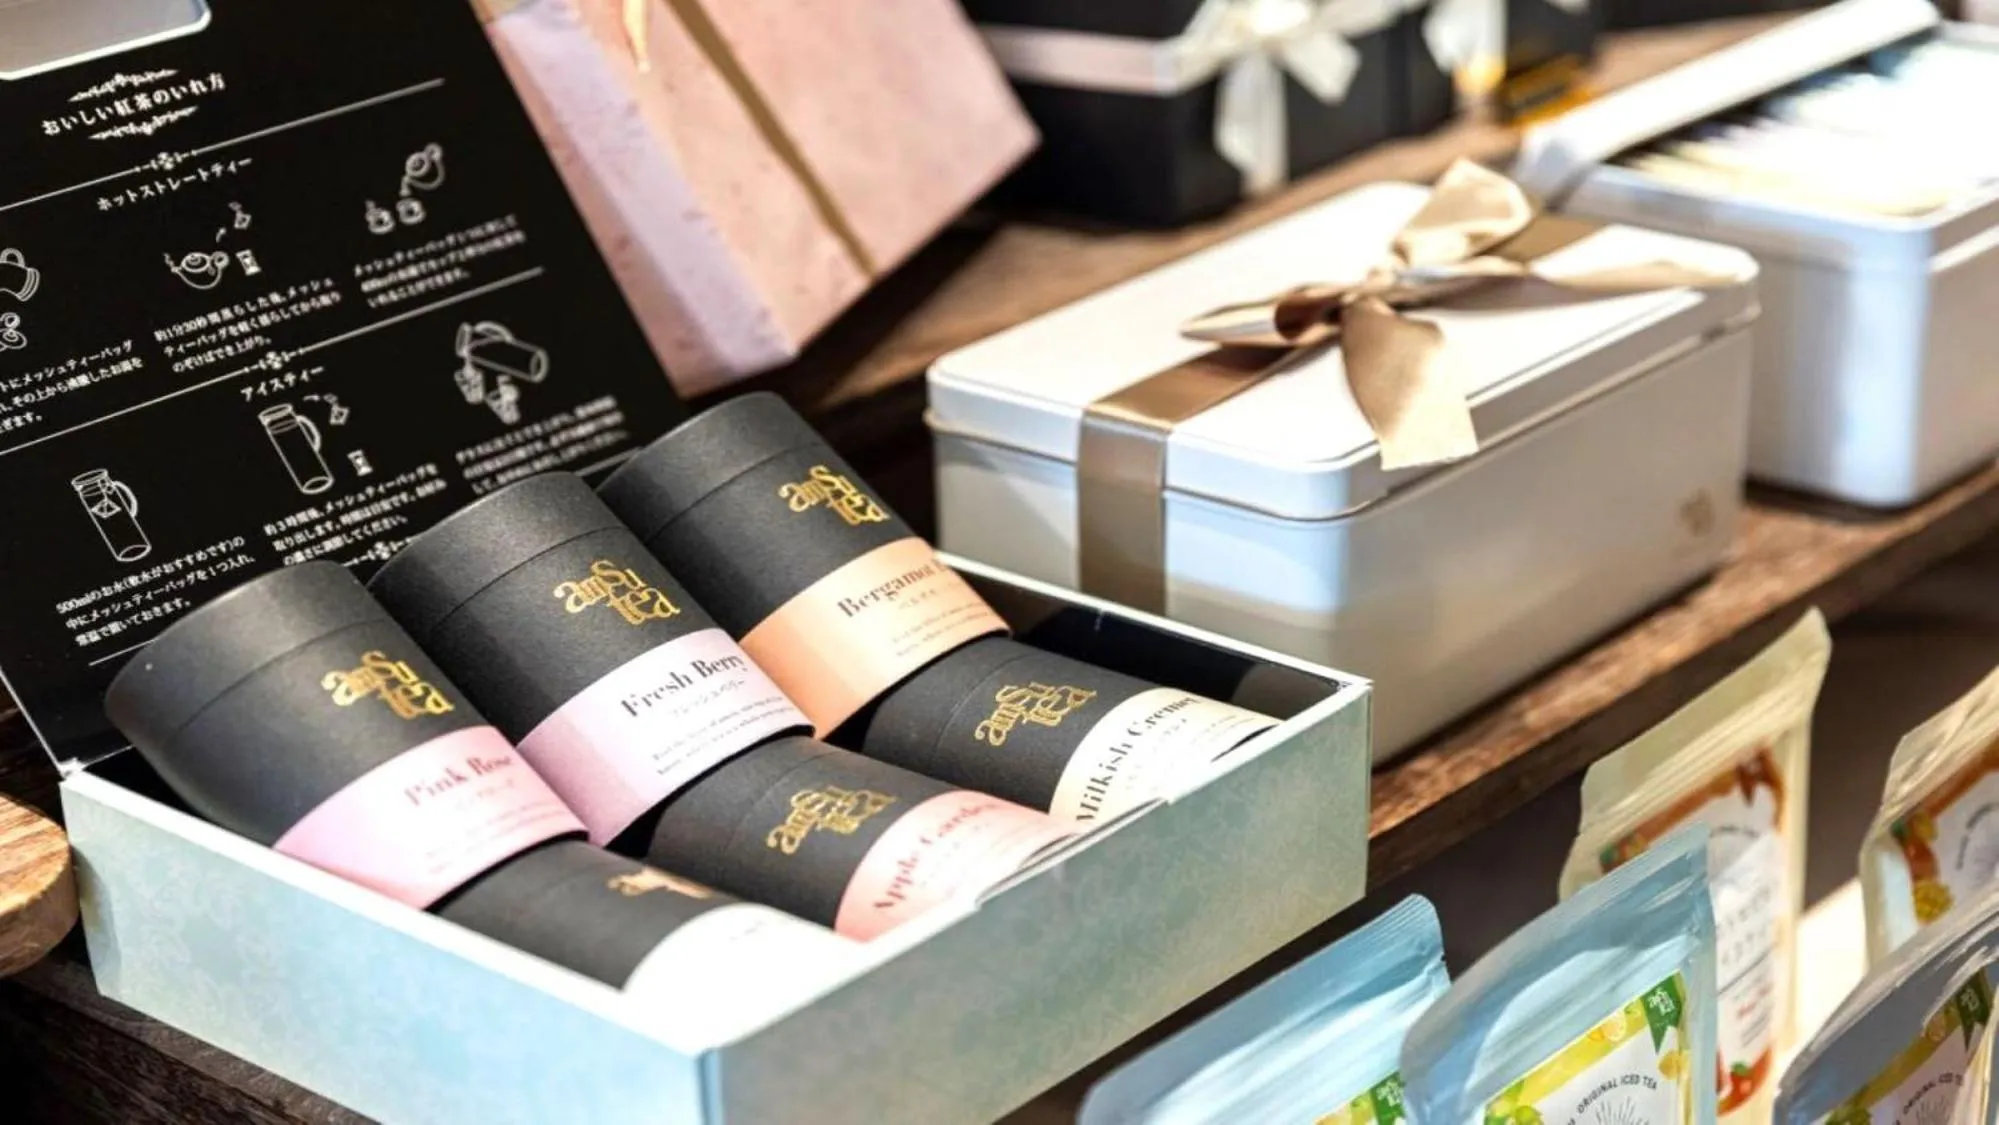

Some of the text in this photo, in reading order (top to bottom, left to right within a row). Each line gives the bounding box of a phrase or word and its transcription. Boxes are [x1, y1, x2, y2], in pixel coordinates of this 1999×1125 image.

[41, 72, 226, 136] おいしい紅茶のいれ方
[97, 157, 252, 211] ホットストレートティー
[240, 366, 324, 402] アイスティー
[621, 655, 749, 717] Fresh Berry
[404, 767, 469, 806] Pink
[1076, 742, 1133, 821] Milkish
[873, 850, 919, 908] Apple
[1576, 1074, 1657, 1114] ORIGINAL ICED TEA
